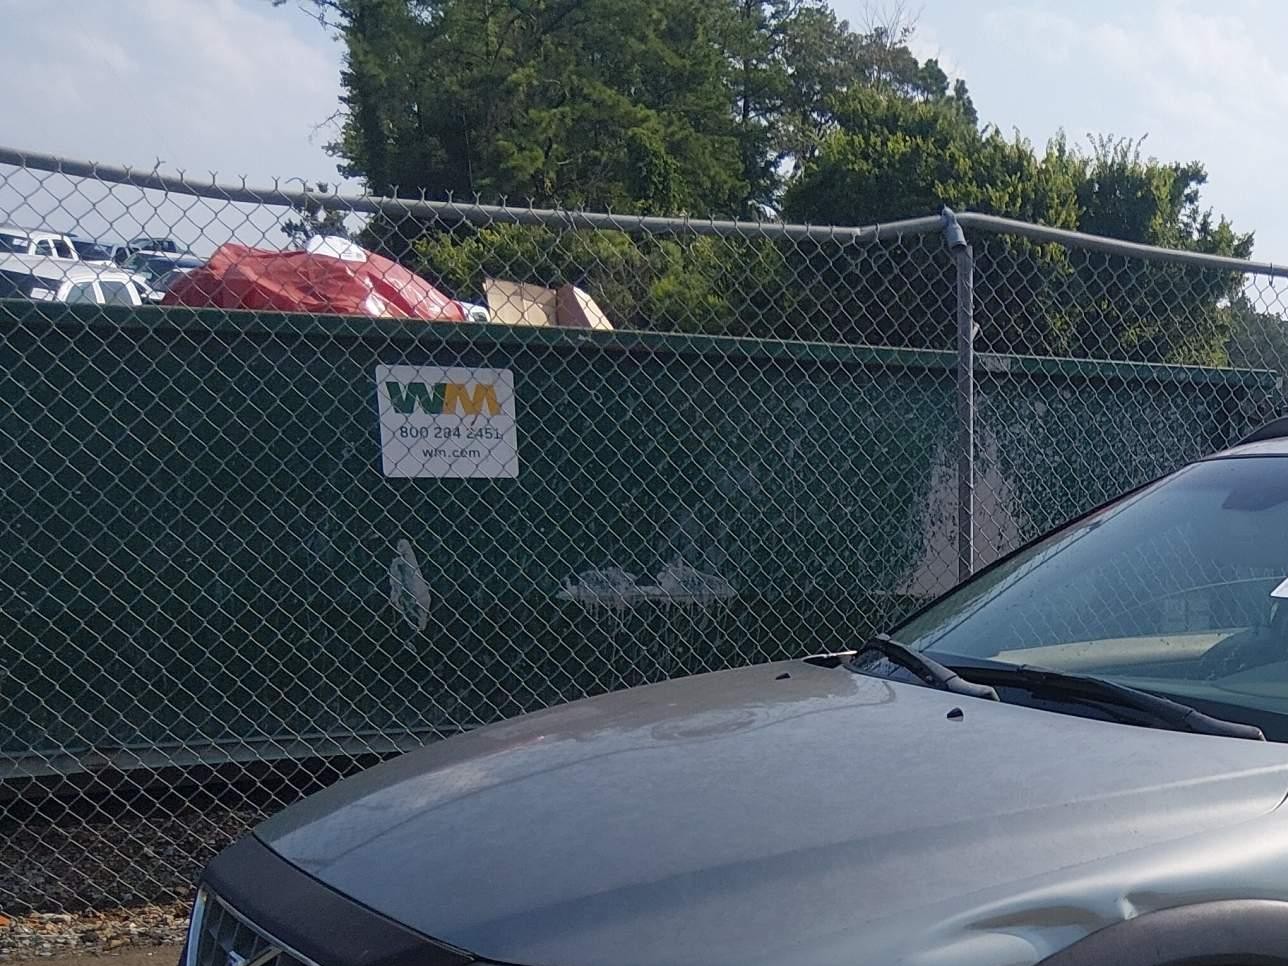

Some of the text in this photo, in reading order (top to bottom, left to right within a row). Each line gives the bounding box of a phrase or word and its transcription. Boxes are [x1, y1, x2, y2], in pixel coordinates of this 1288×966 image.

[385, 381, 501, 416] WM
[400, 426, 429, 438] 800
[466, 427, 502, 440] 2451
[422, 448, 481, 458] wm.com
